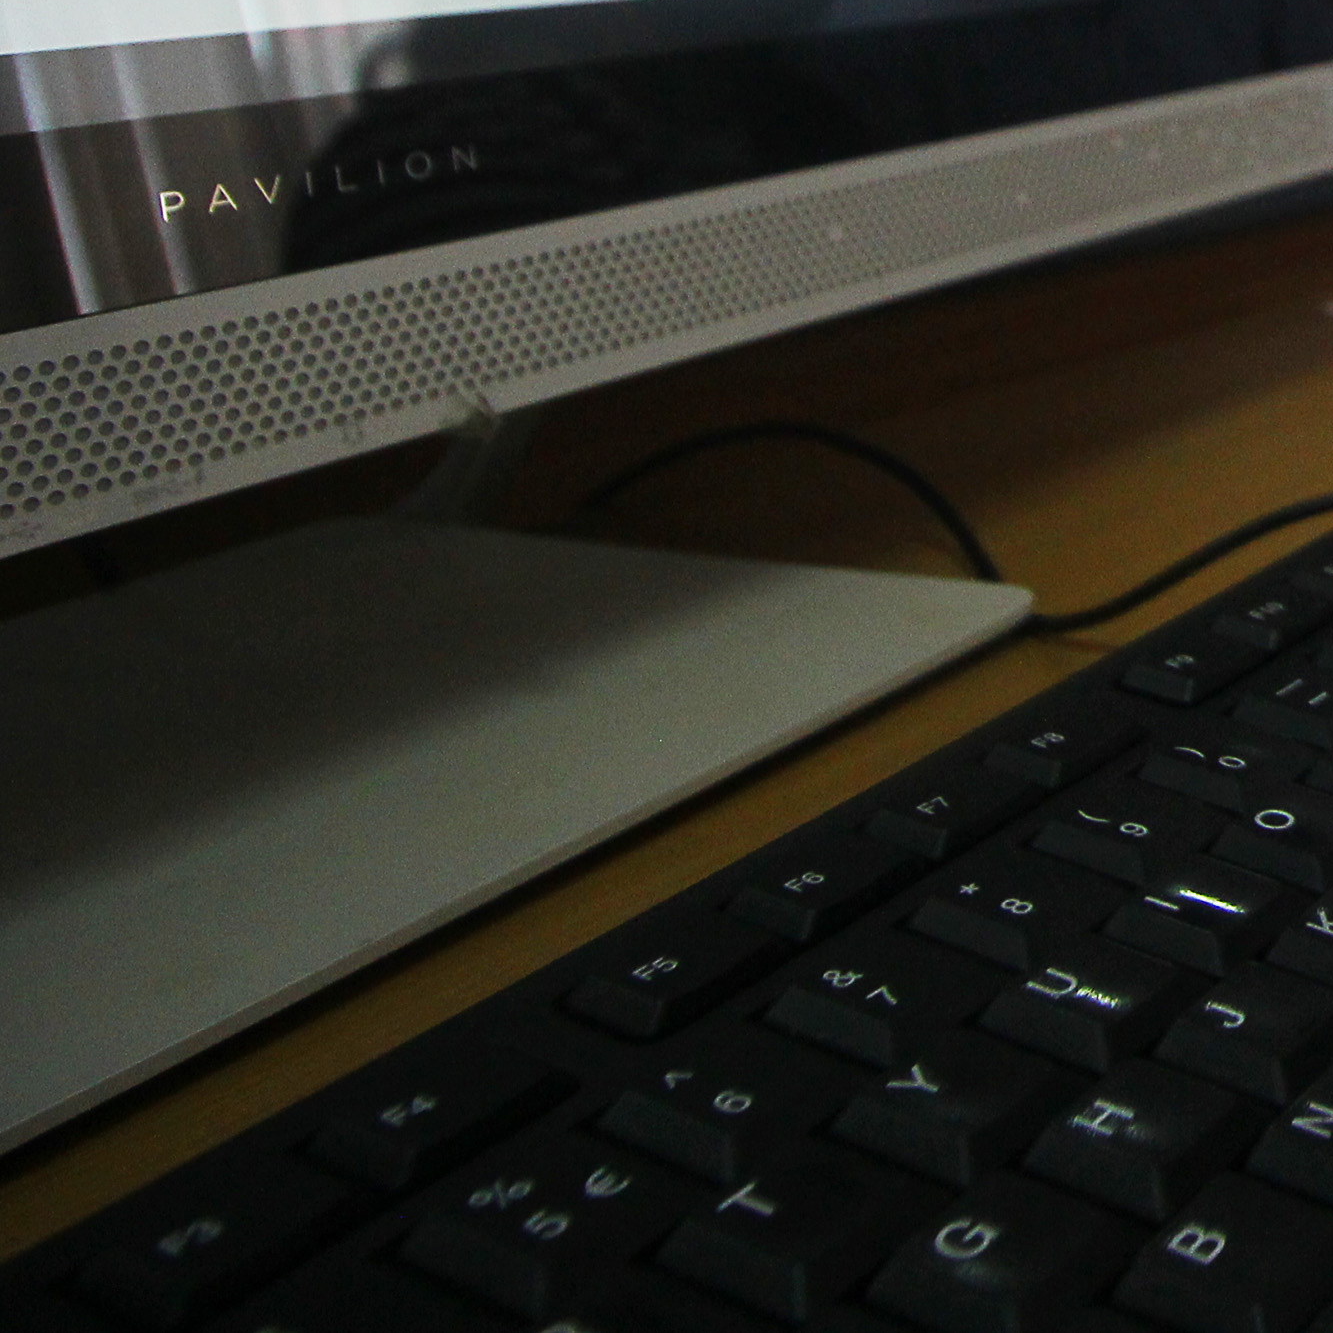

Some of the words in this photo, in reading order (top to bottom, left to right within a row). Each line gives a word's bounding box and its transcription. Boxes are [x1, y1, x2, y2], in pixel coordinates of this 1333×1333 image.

[159, 144, 478, 223] PAVILION
[1030, 731, 1066, 750] F8
[914, 794, 950, 817] F7
[783, 870, 827, 894] F6
[1000, 896, 1035, 915] 8
[631, 955, 680, 982] F5
[1026, 966, 1080, 1000] U
[865, 984, 899, 1007] 7
[1204, 999, 1247, 1030] J
[886, 1062, 940, 1094] Y
[713, 1089, 754, 1115] 6
[1071, 1097, 1136, 1137] H
[716, 1180, 776, 1217] T
[522, 1208, 571, 1240] 5
[933, 1218, 1000, 1261] G
[1166, 1223, 1227, 1266] B
